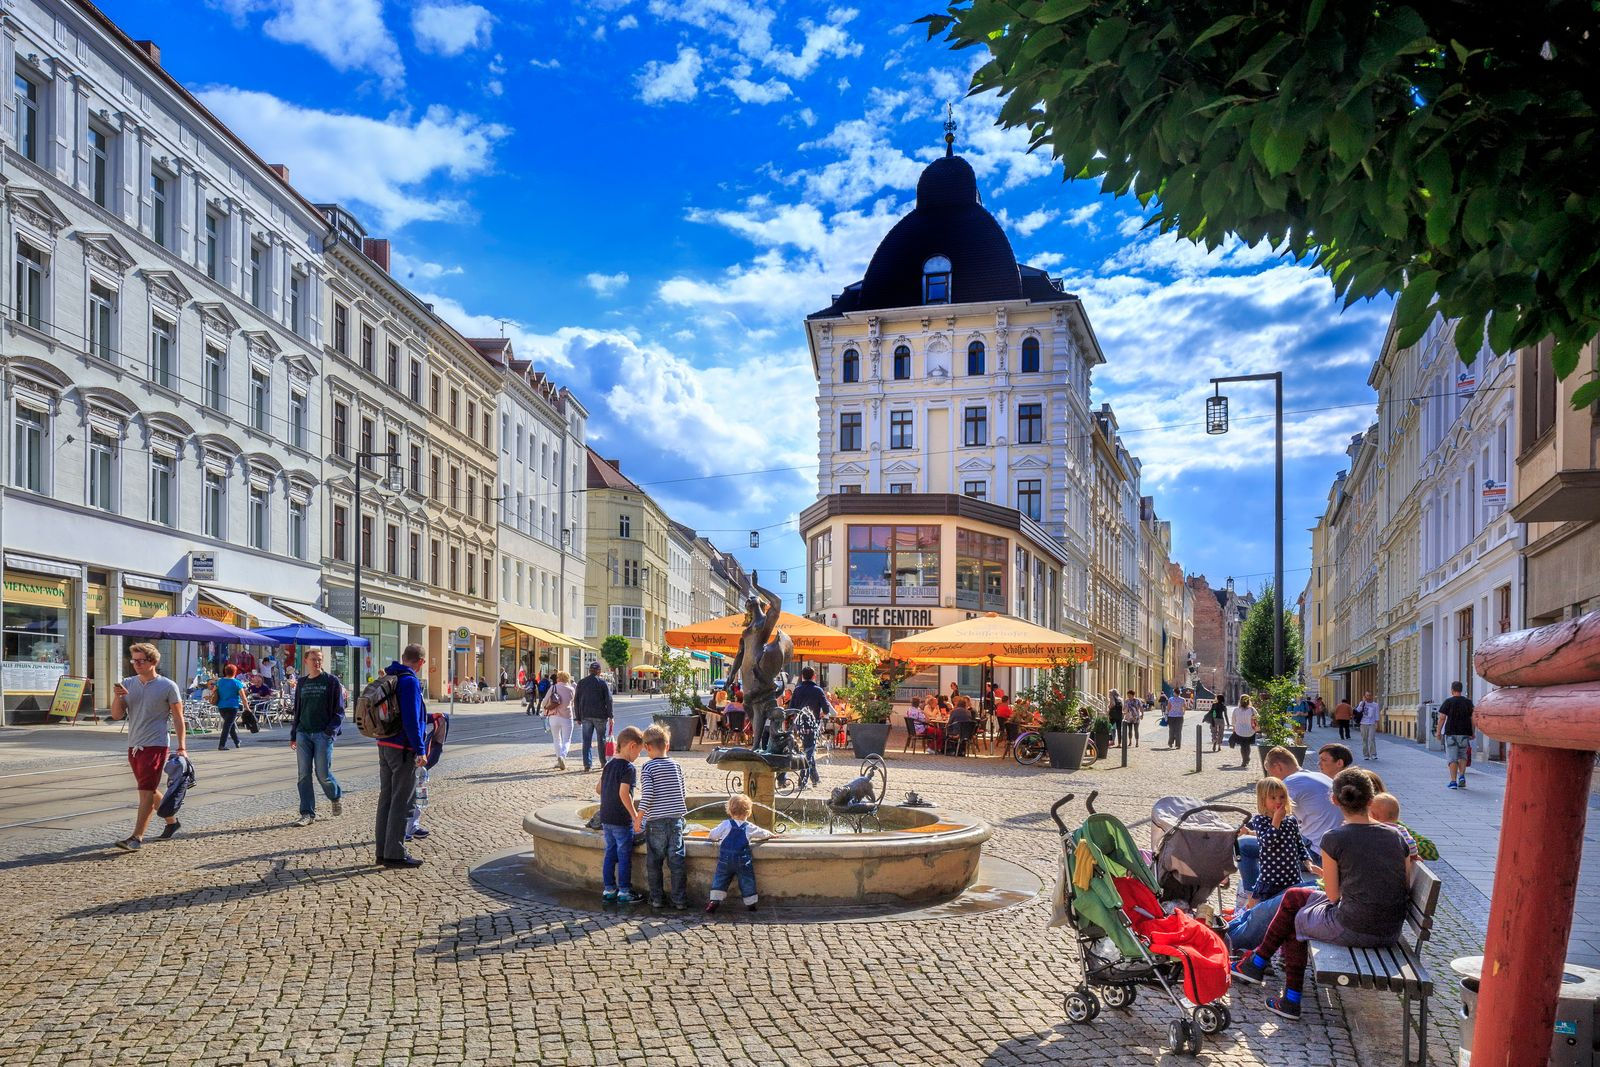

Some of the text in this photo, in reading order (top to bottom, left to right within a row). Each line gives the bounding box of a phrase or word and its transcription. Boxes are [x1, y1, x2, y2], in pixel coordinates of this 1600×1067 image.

[3, 581, 65, 597] VIETNAM-WOK
[912, 587, 938, 596] CENTRAL
[123, 597, 169, 611] VIETNAM-WOK
[853, 608, 933, 626] CAFÉ CENTRAL
[691, 633, 727, 645] Schöfferhofer
[793, 638, 820, 647] öfferhofer
[1003, 643, 1088, 655] Schöfferhofer WEIZEN
